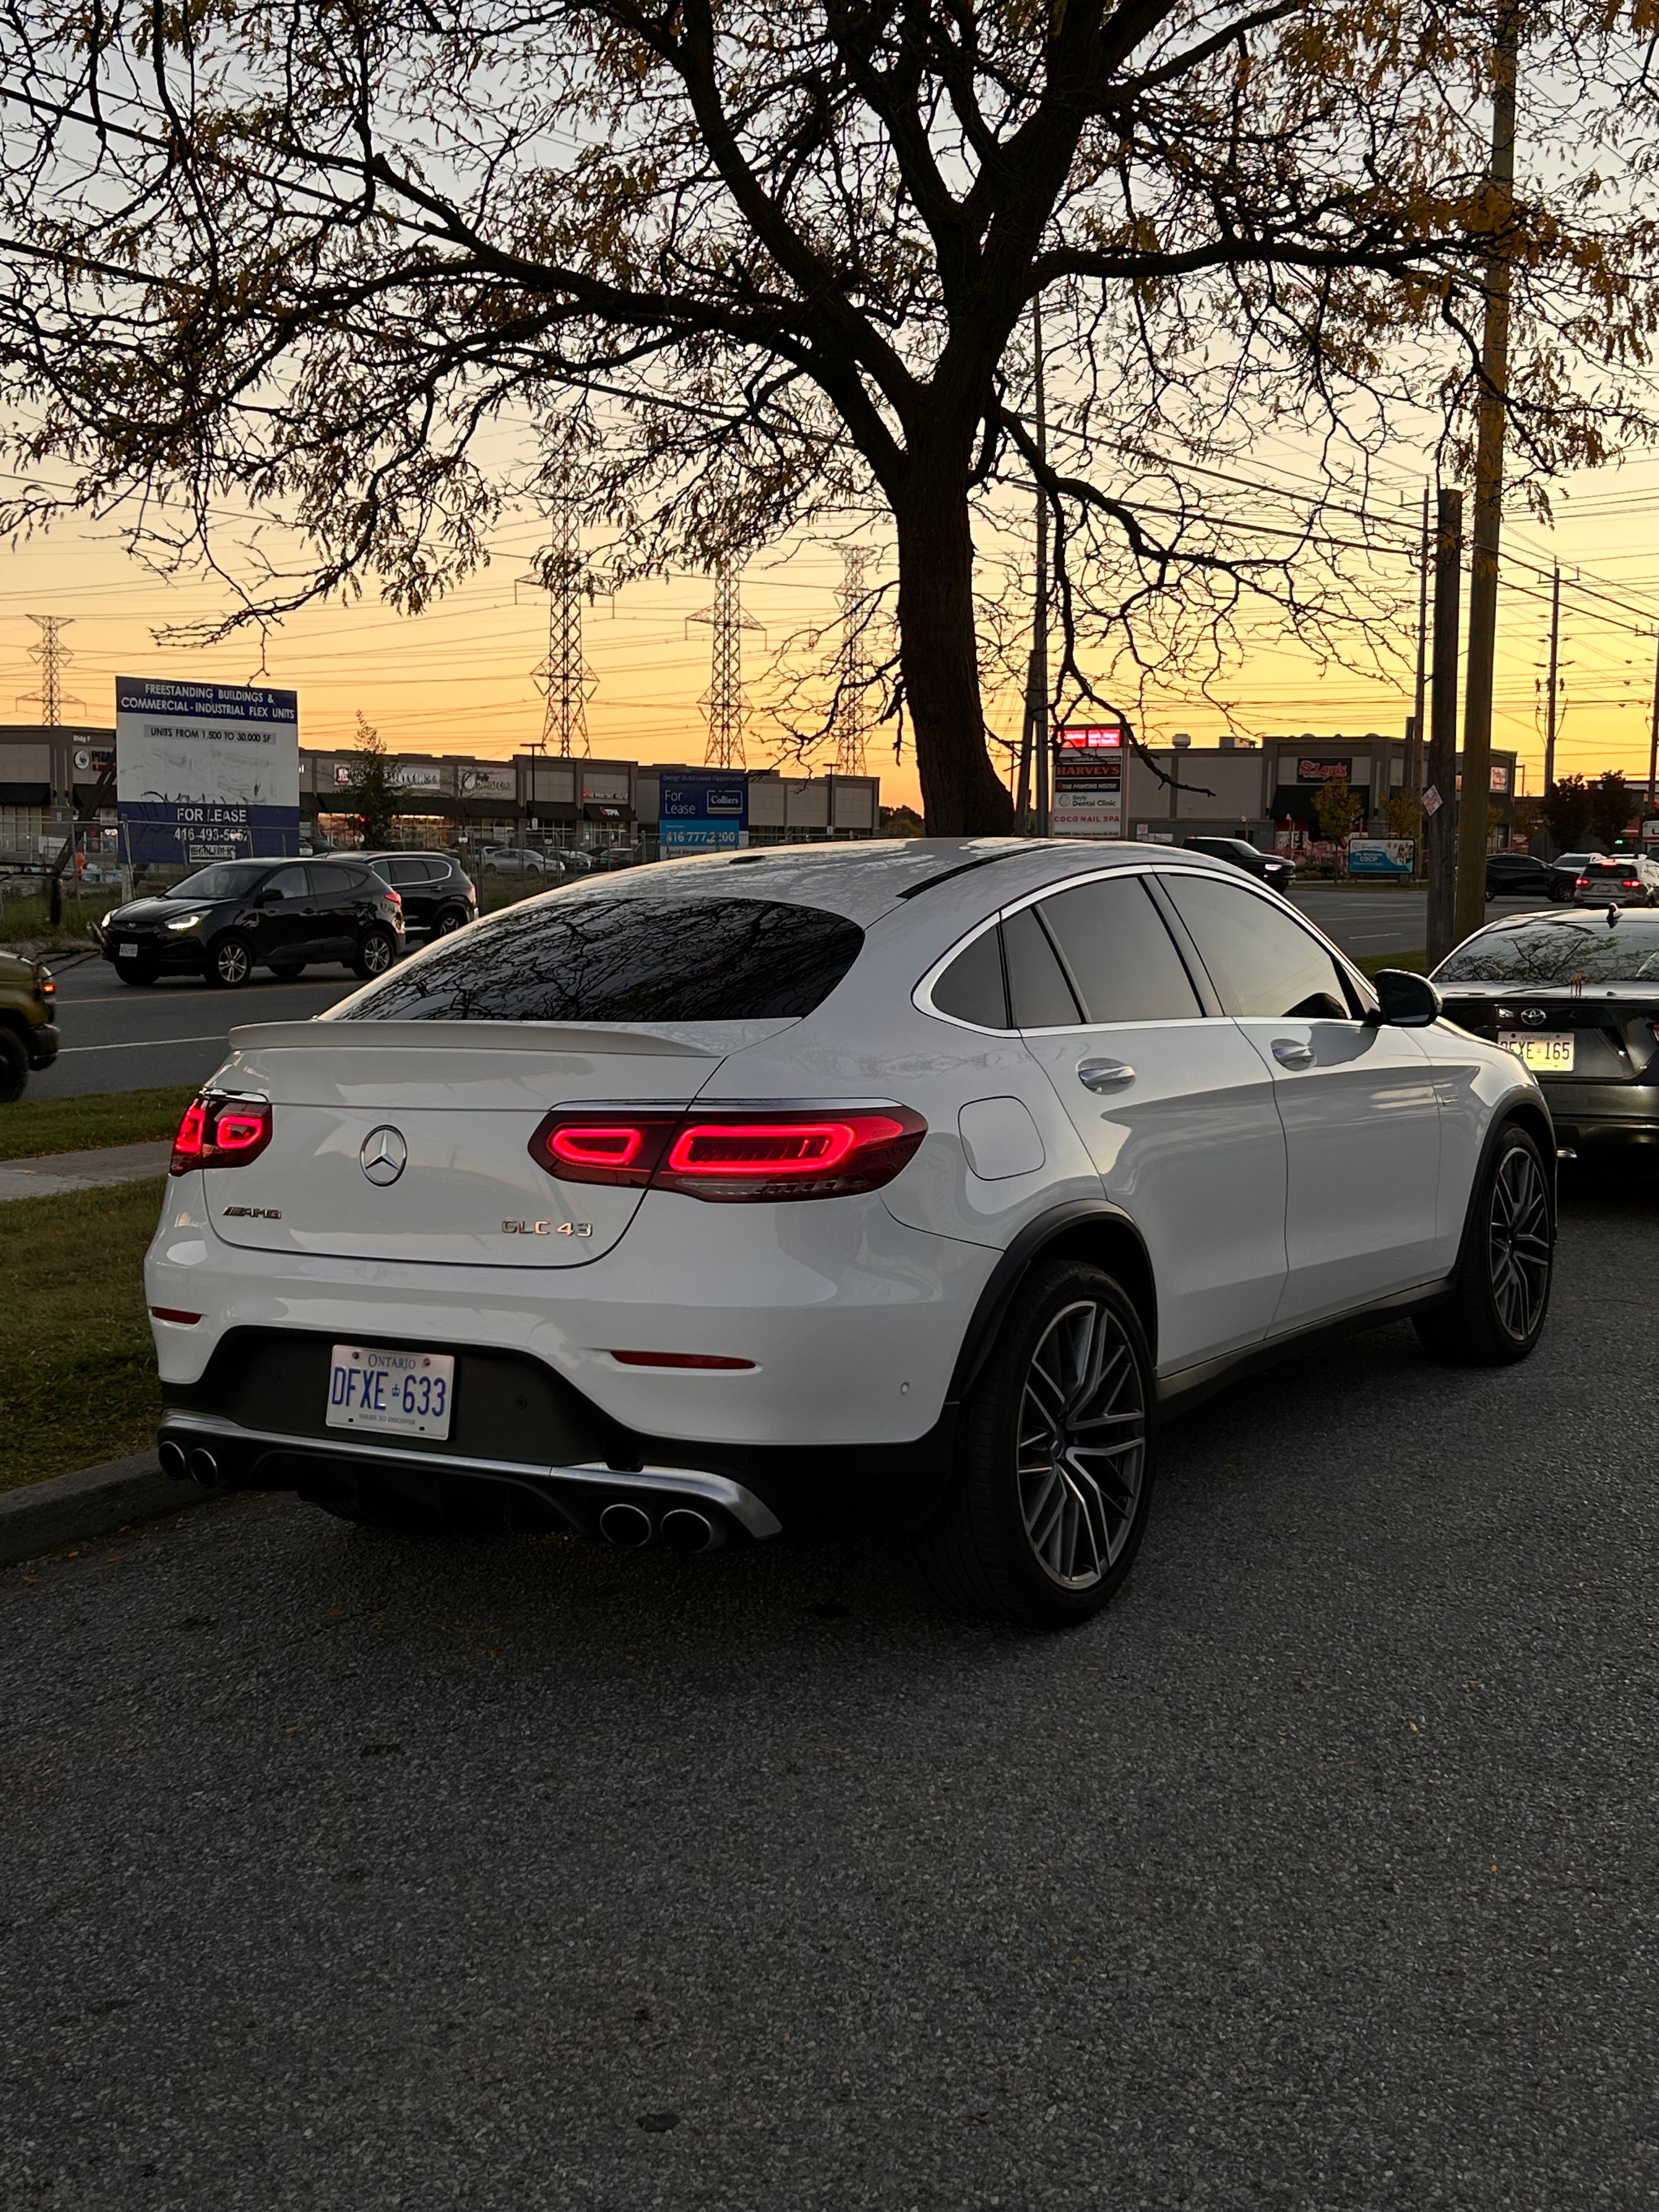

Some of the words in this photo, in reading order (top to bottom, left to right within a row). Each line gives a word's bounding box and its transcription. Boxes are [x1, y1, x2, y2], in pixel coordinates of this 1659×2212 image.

[145, 684, 213, 698] FREESTANDING
[218, 689, 263, 702] BUILDINGS
[267, 693, 274, 703] &
[121, 696, 189, 712] COMMERCIAL
[195, 702, 245, 715] INDUSTRIAL
[249, 707, 268, 718] FLEX
[272, 708, 295, 719] UNITS
[151, 727, 172, 737] UNITS
[176, 729, 199, 738] FROM
[202, 731, 222, 740] 1,500
[224, 732, 234, 741] TO
[237, 732, 261, 742] 30,000
[1057, 766, 1120, 775] HARVEY'S
[665, 789, 683, 802] For
[711, 795, 739, 804] Colliers
[177, 808, 204, 821] FOR
[207, 809, 247, 822] LEASE
[665, 802, 696, 814] Lease
[666, 832, 684, 843] 416
[1544, 1042, 1571, 1060] 165
[239, 1207, 281, 1219] AMG
[502, 1219, 550, 1235] GLC
[556, 1222, 593, 1237] 43
[368, 1353, 416, 1371] ONTARIO
[331, 1366, 389, 1410] DFXE
[402, 1374, 447, 1417] 633
